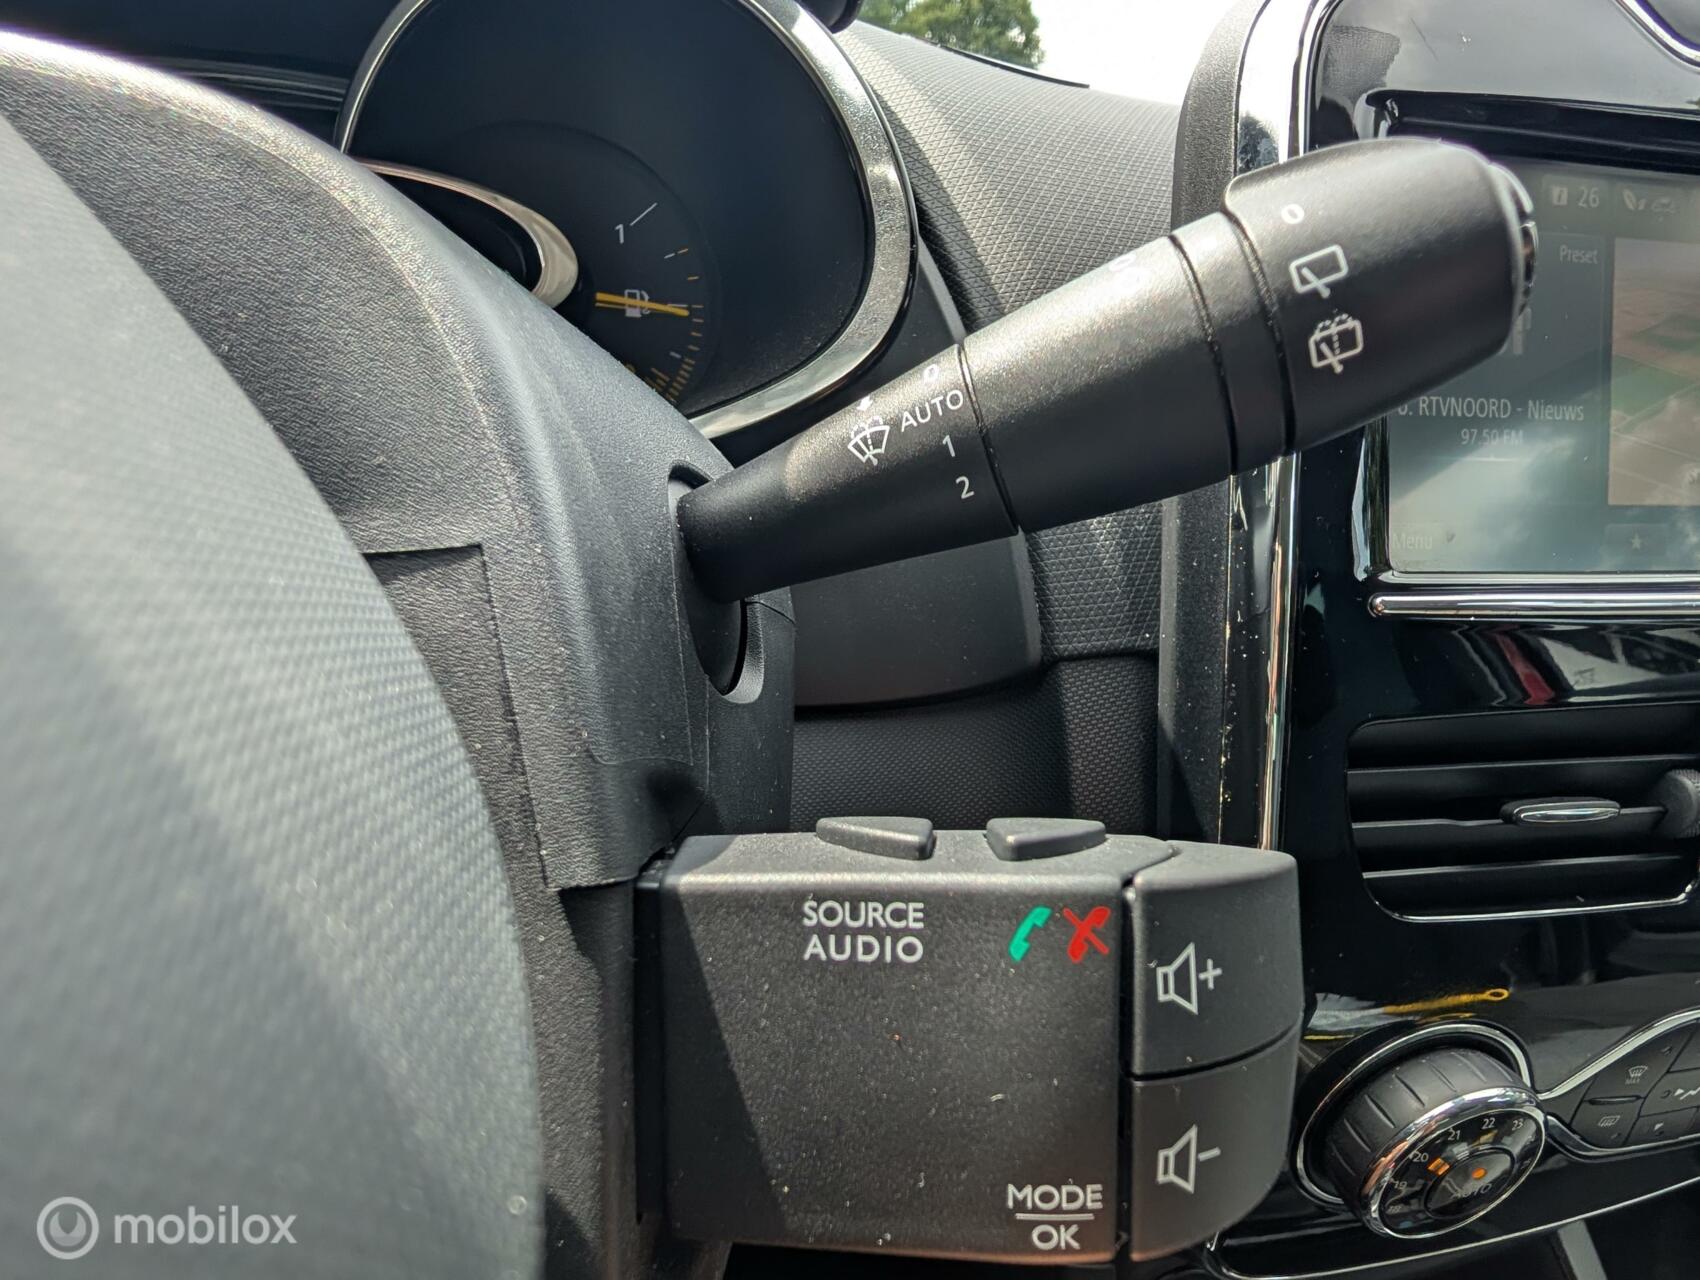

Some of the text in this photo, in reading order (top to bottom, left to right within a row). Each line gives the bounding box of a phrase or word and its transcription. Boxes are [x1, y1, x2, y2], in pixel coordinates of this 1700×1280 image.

[1577, 186, 1600, 208] 26
[614, 223, 625, 244] 1
[1559, 244, 1600, 265] Preset
[900, 389, 964, 433] AUTO
[1418, 396, 1511, 419] RTVNOORD
[1527, 400, 1584, 421] Nieuws
[942, 434, 956, 458] 1
[1460, 428, 1499, 445] 97.50
[955, 475, 975, 500] 2
[1391, 532, 1433, 550] Menu
[803, 900, 925, 930] SOURCE
[803, 935, 924, 963] AUDIO
[1447, 1128, 1461, 1141] 21
[1481, 1117, 1496, 1130] 22
[1511, 1118, 1524, 1131] 23
[1412, 1150, 1430, 1163] 20
[1007, 1183, 1104, 1211] MODE
[1031, 1224, 1081, 1251] OK
